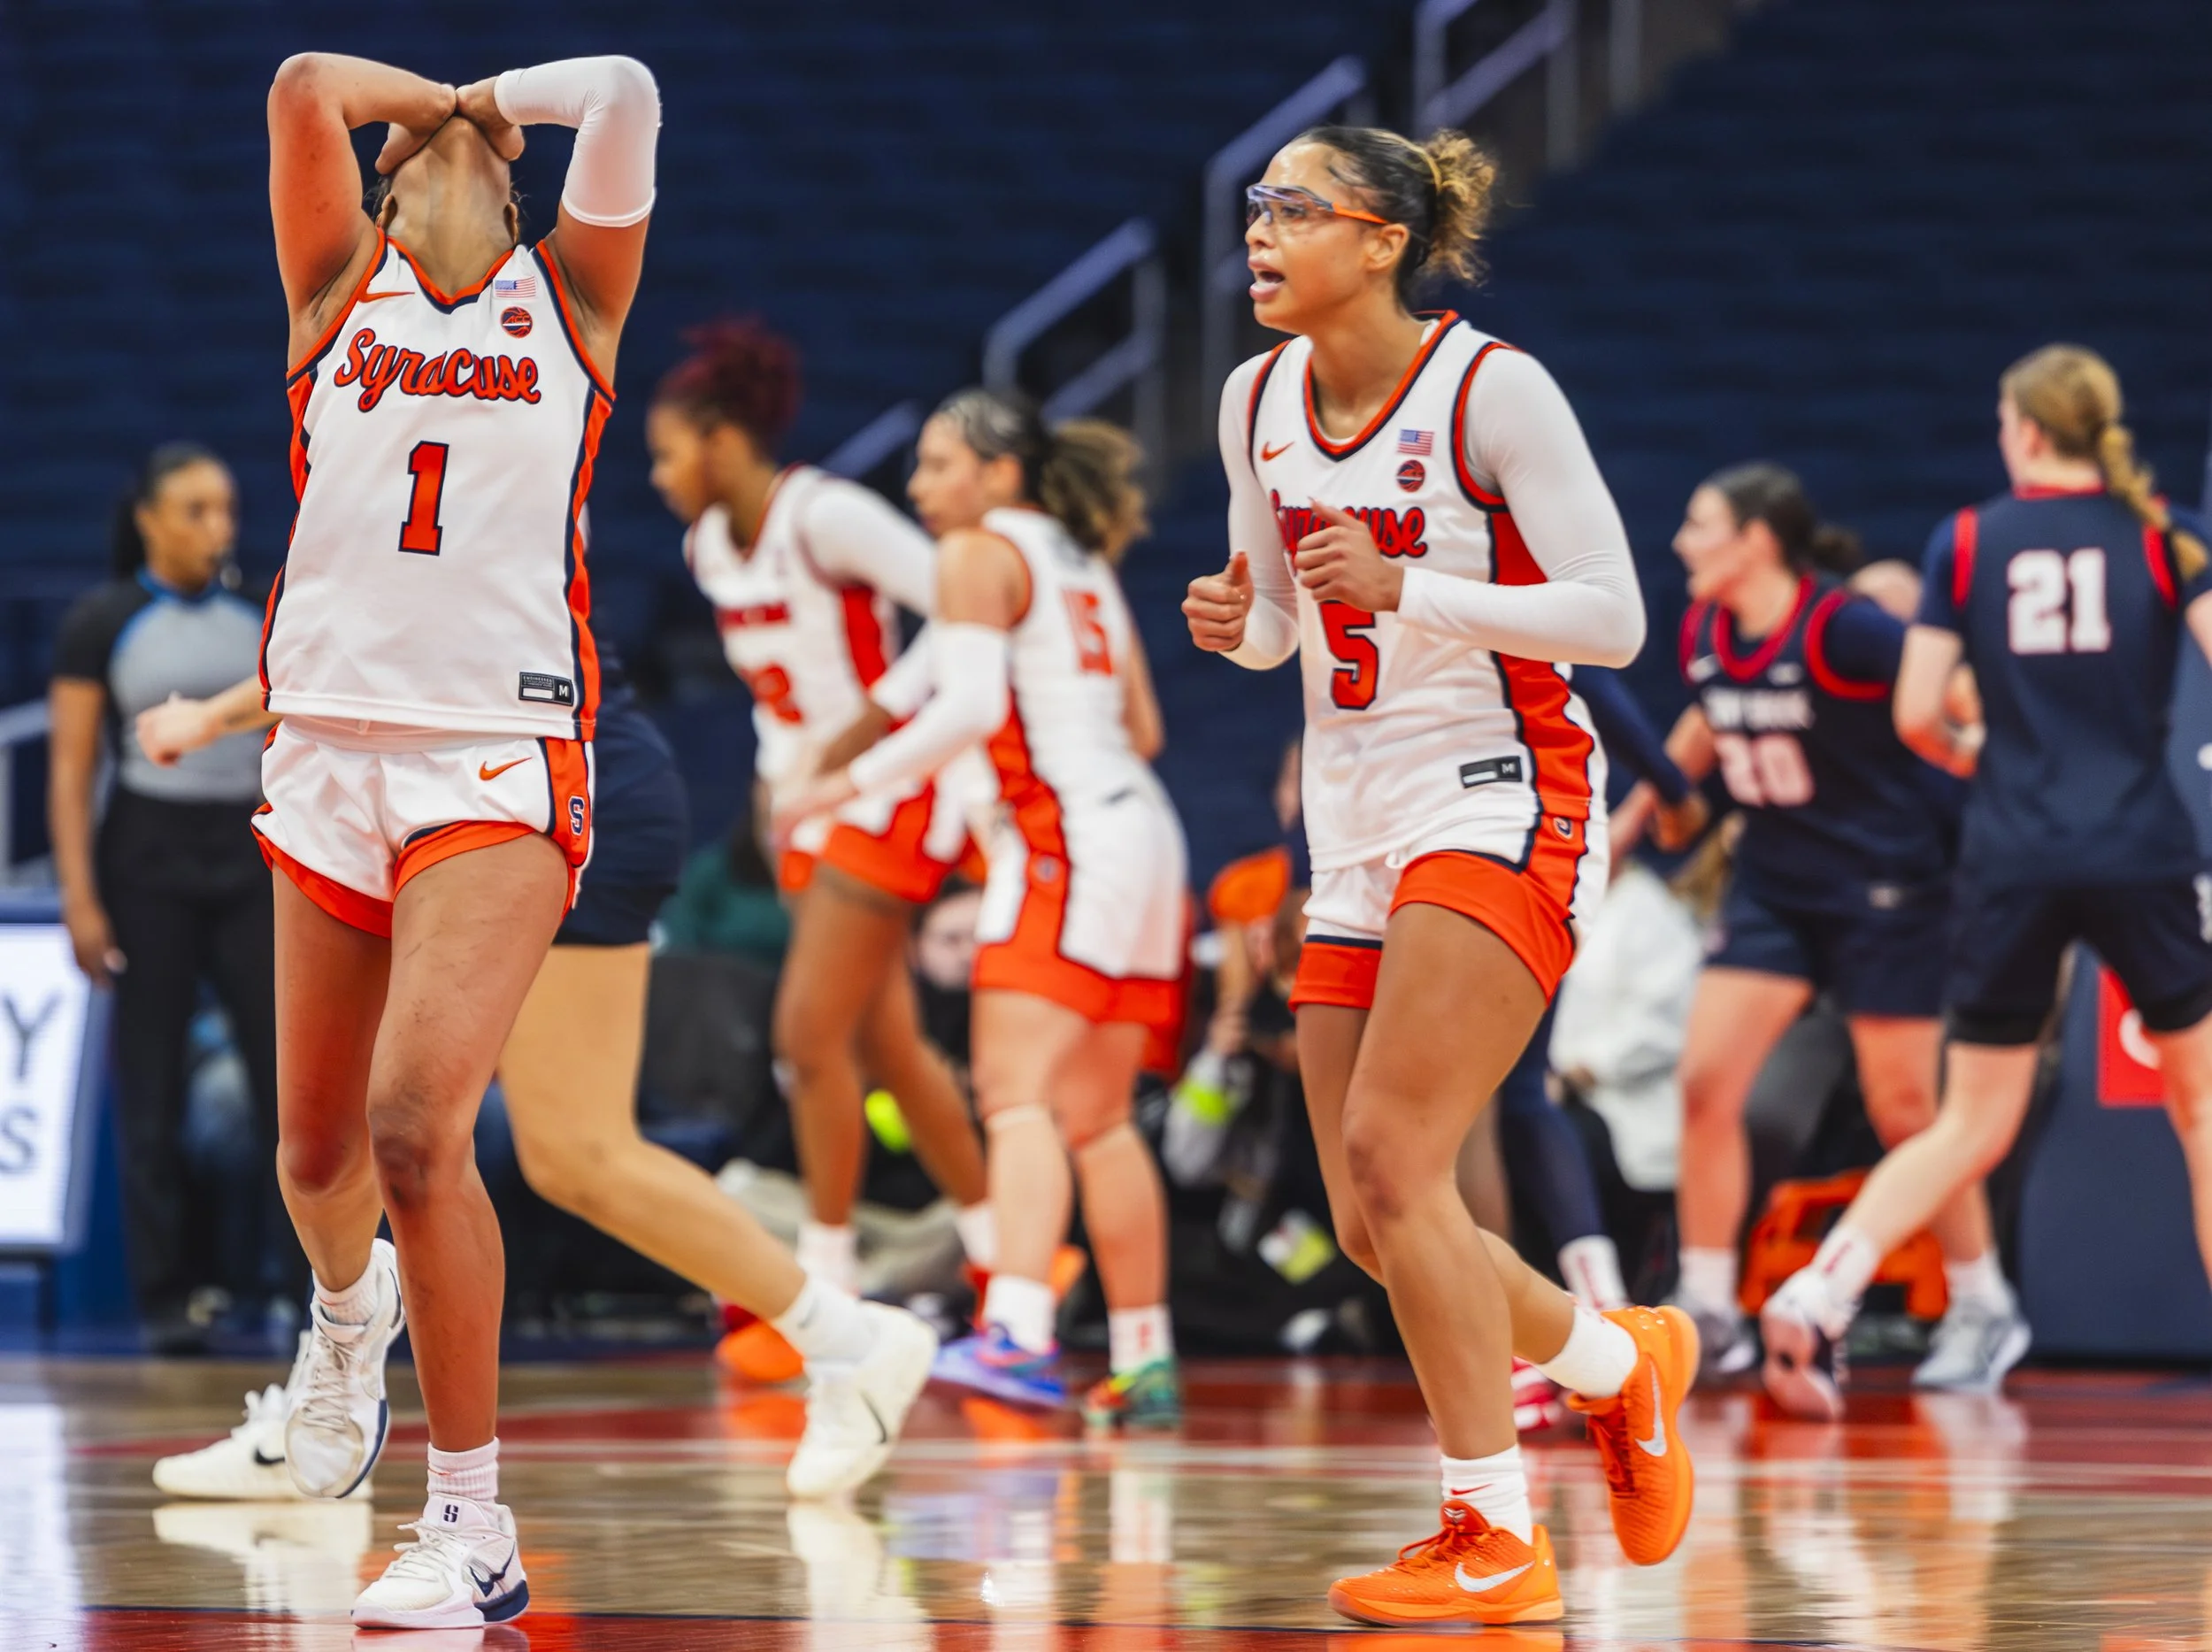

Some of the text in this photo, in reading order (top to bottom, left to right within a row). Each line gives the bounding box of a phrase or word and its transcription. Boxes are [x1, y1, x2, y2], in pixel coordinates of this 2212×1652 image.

[334, 327, 541, 412] Syracuse
[398, 441, 449, 556] 1
[2008, 547, 2111, 656] 21
[558, 684, 569, 697] M
[1318, 599, 1379, 711] 5
[569, 795, 585, 836] S
